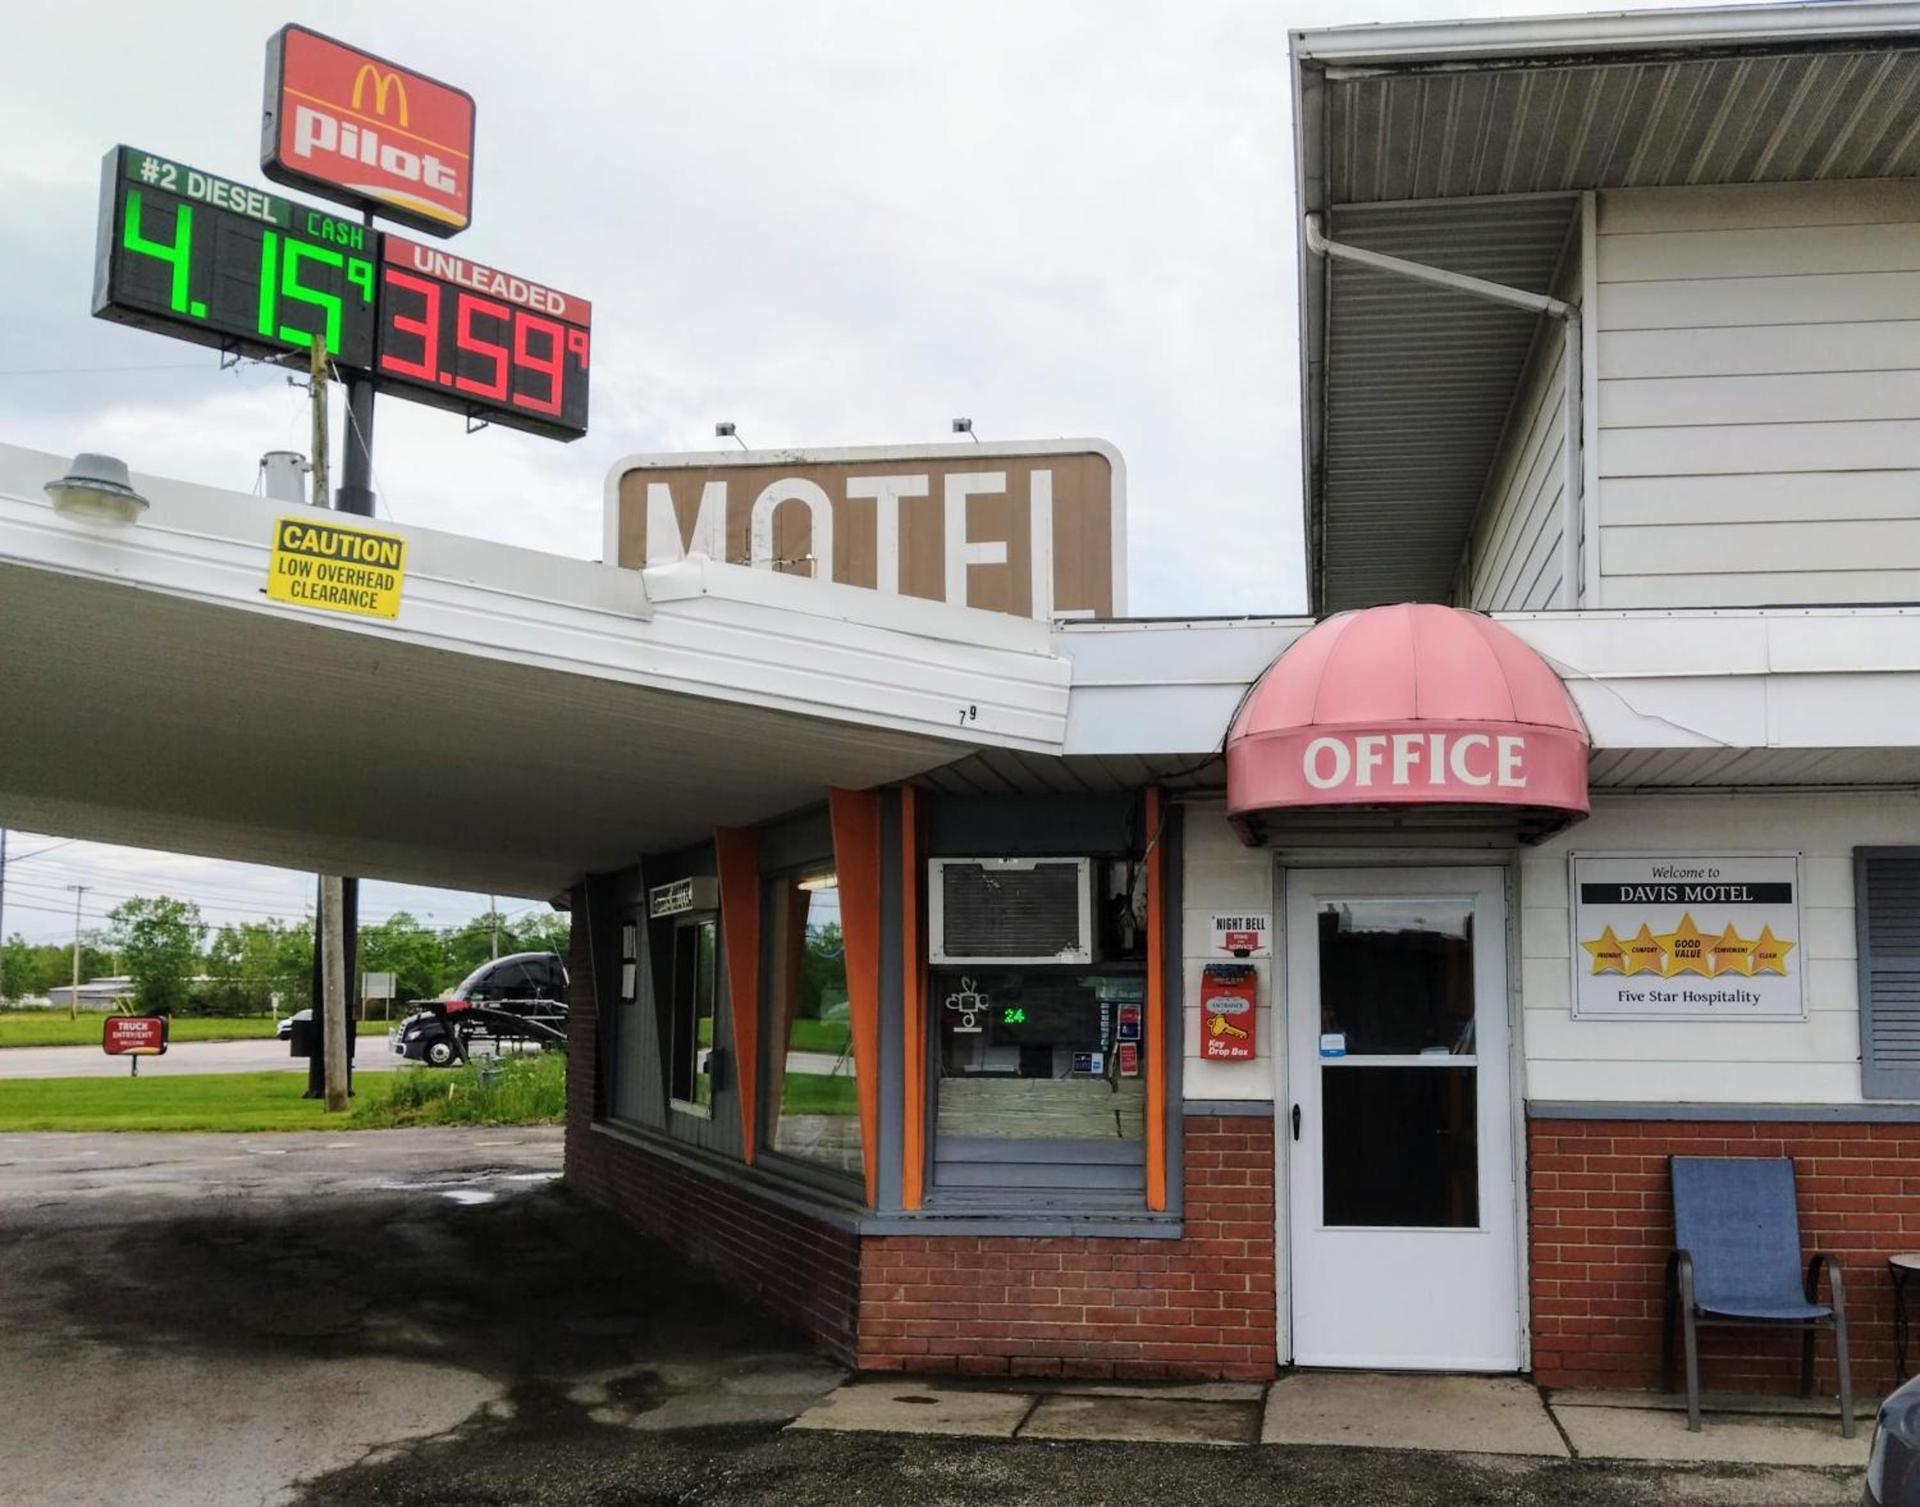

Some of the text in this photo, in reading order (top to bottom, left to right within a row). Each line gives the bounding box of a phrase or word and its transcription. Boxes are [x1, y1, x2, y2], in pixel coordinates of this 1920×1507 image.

[140, 156, 278, 224] #2 DIESEL
[306, 212, 363, 250] CASH
[413, 246, 565, 316] UNLEADED
[283, 525, 398, 566] CAUTION
[647, 469, 1095, 619] MOTEL
[278, 557, 394, 591] LOW OVERHEAD
[291, 580, 379, 609] CLEARANCE
[1303, 733, 1527, 789] OFFICE
[1652, 865, 1720, 879] Welcome to
[1620, 885, 1753, 902] DAVIS MOTEL
[1216, 917, 1266, 930] NIGHT BELL
[1674, 939, 1701, 949] GOOD
[1674, 949, 1701, 959] VALUE
[1618, 989, 1761, 1006] Five Star Hospitality
[1004, 1008, 1024, 1023] 24
[117, 1022, 149, 1031] TRUCK
[1208, 1039, 1225, 1049] Key
[1208, 1047, 1248, 1057] Drop Box
